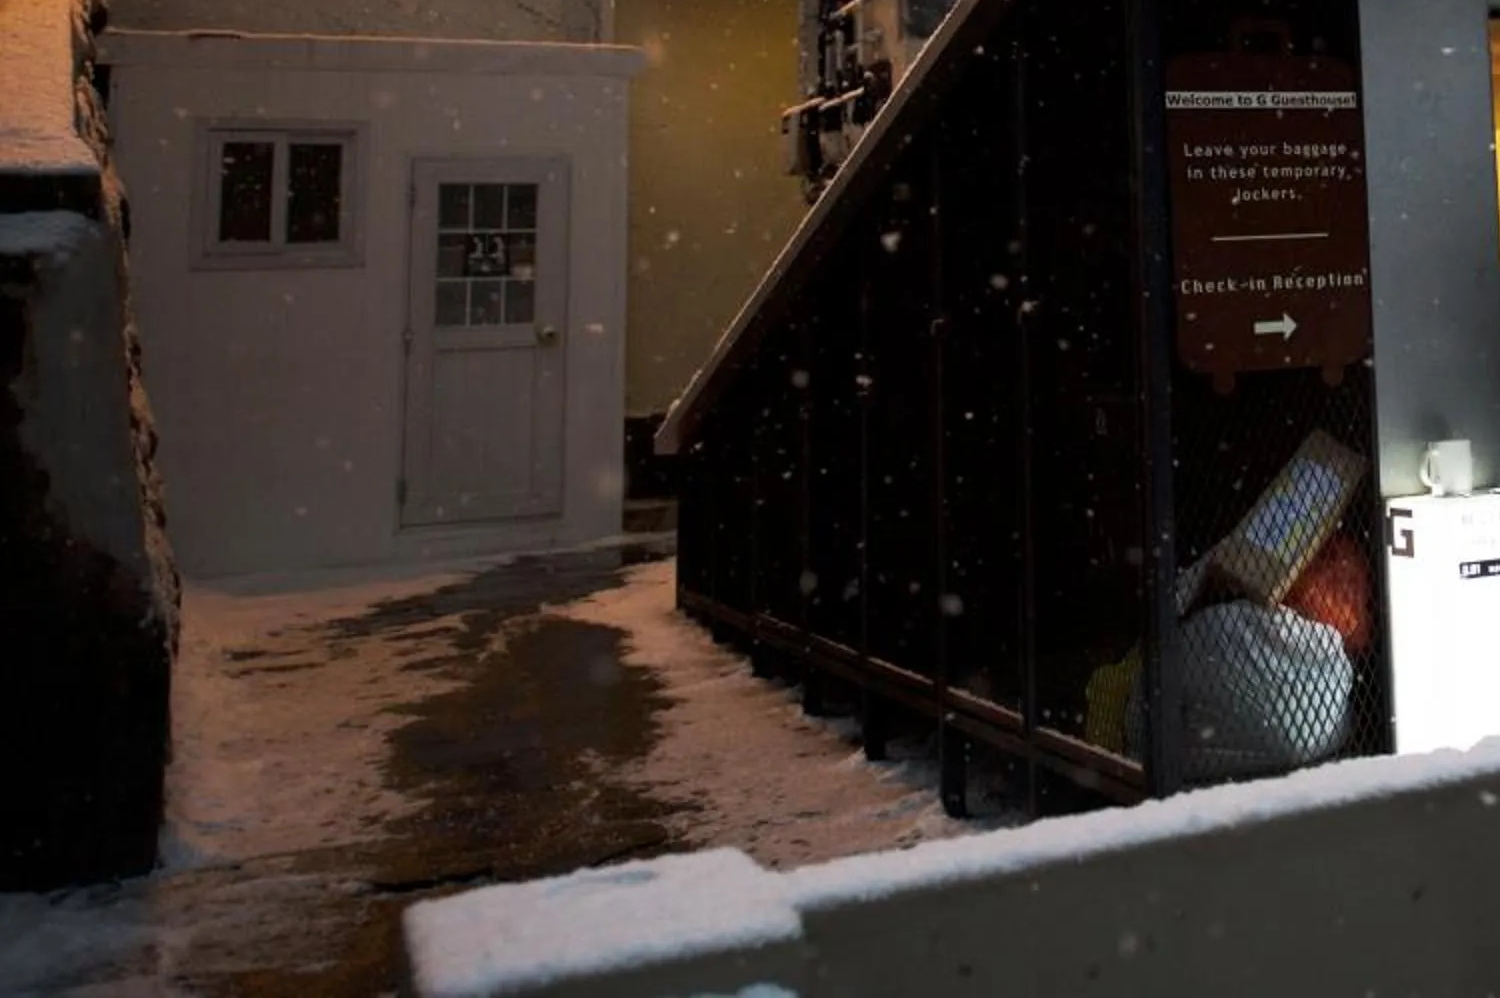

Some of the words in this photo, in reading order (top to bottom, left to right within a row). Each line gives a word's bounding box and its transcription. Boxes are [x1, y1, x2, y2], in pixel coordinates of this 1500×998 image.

[1167, 93, 1233, 107] Welcome
[1238, 94, 1252, 106] to
[1256, 94, 1267, 106] G
[1184, 143, 1233, 157] Leave
[1240, 146, 1277, 159] your
[1283, 142, 1348, 157] baggage
[1187, 166, 1203, 180] in
[1211, 165, 1257, 179] these
[1181, 276, 1267, 294] Check-in
[1273, 272, 1364, 291] Reception
[1384, 508, 1415, 558] G
